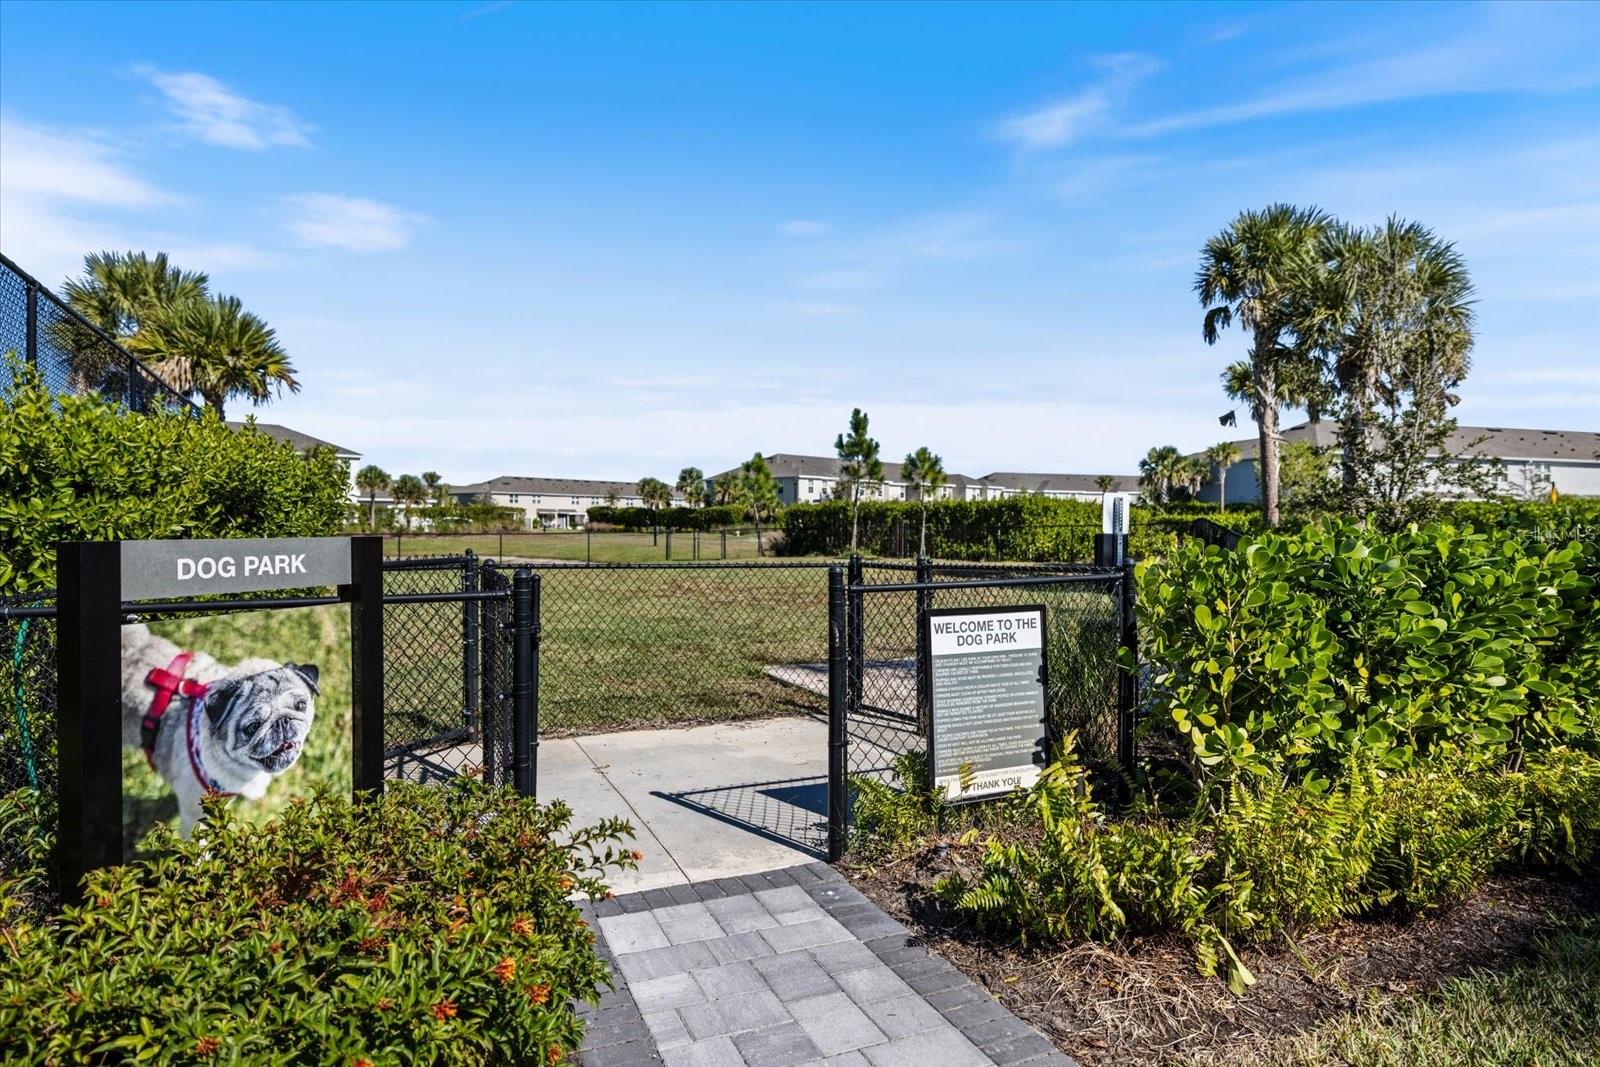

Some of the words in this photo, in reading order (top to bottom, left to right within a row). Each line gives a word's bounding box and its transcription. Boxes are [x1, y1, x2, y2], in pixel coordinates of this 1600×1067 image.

[177, 557, 236, 580] DOG
[244, 554, 306, 577] PARK
[934, 620, 994, 634] WELCOME
[997, 619, 1012, 630] TO
[1015, 618, 1037, 629] THE
[957, 634, 982, 646] DOG
[986, 632, 1017, 644] PARK
[972, 779, 1000, 791] THANK
[1001, 776, 1021, 787] YOU!
